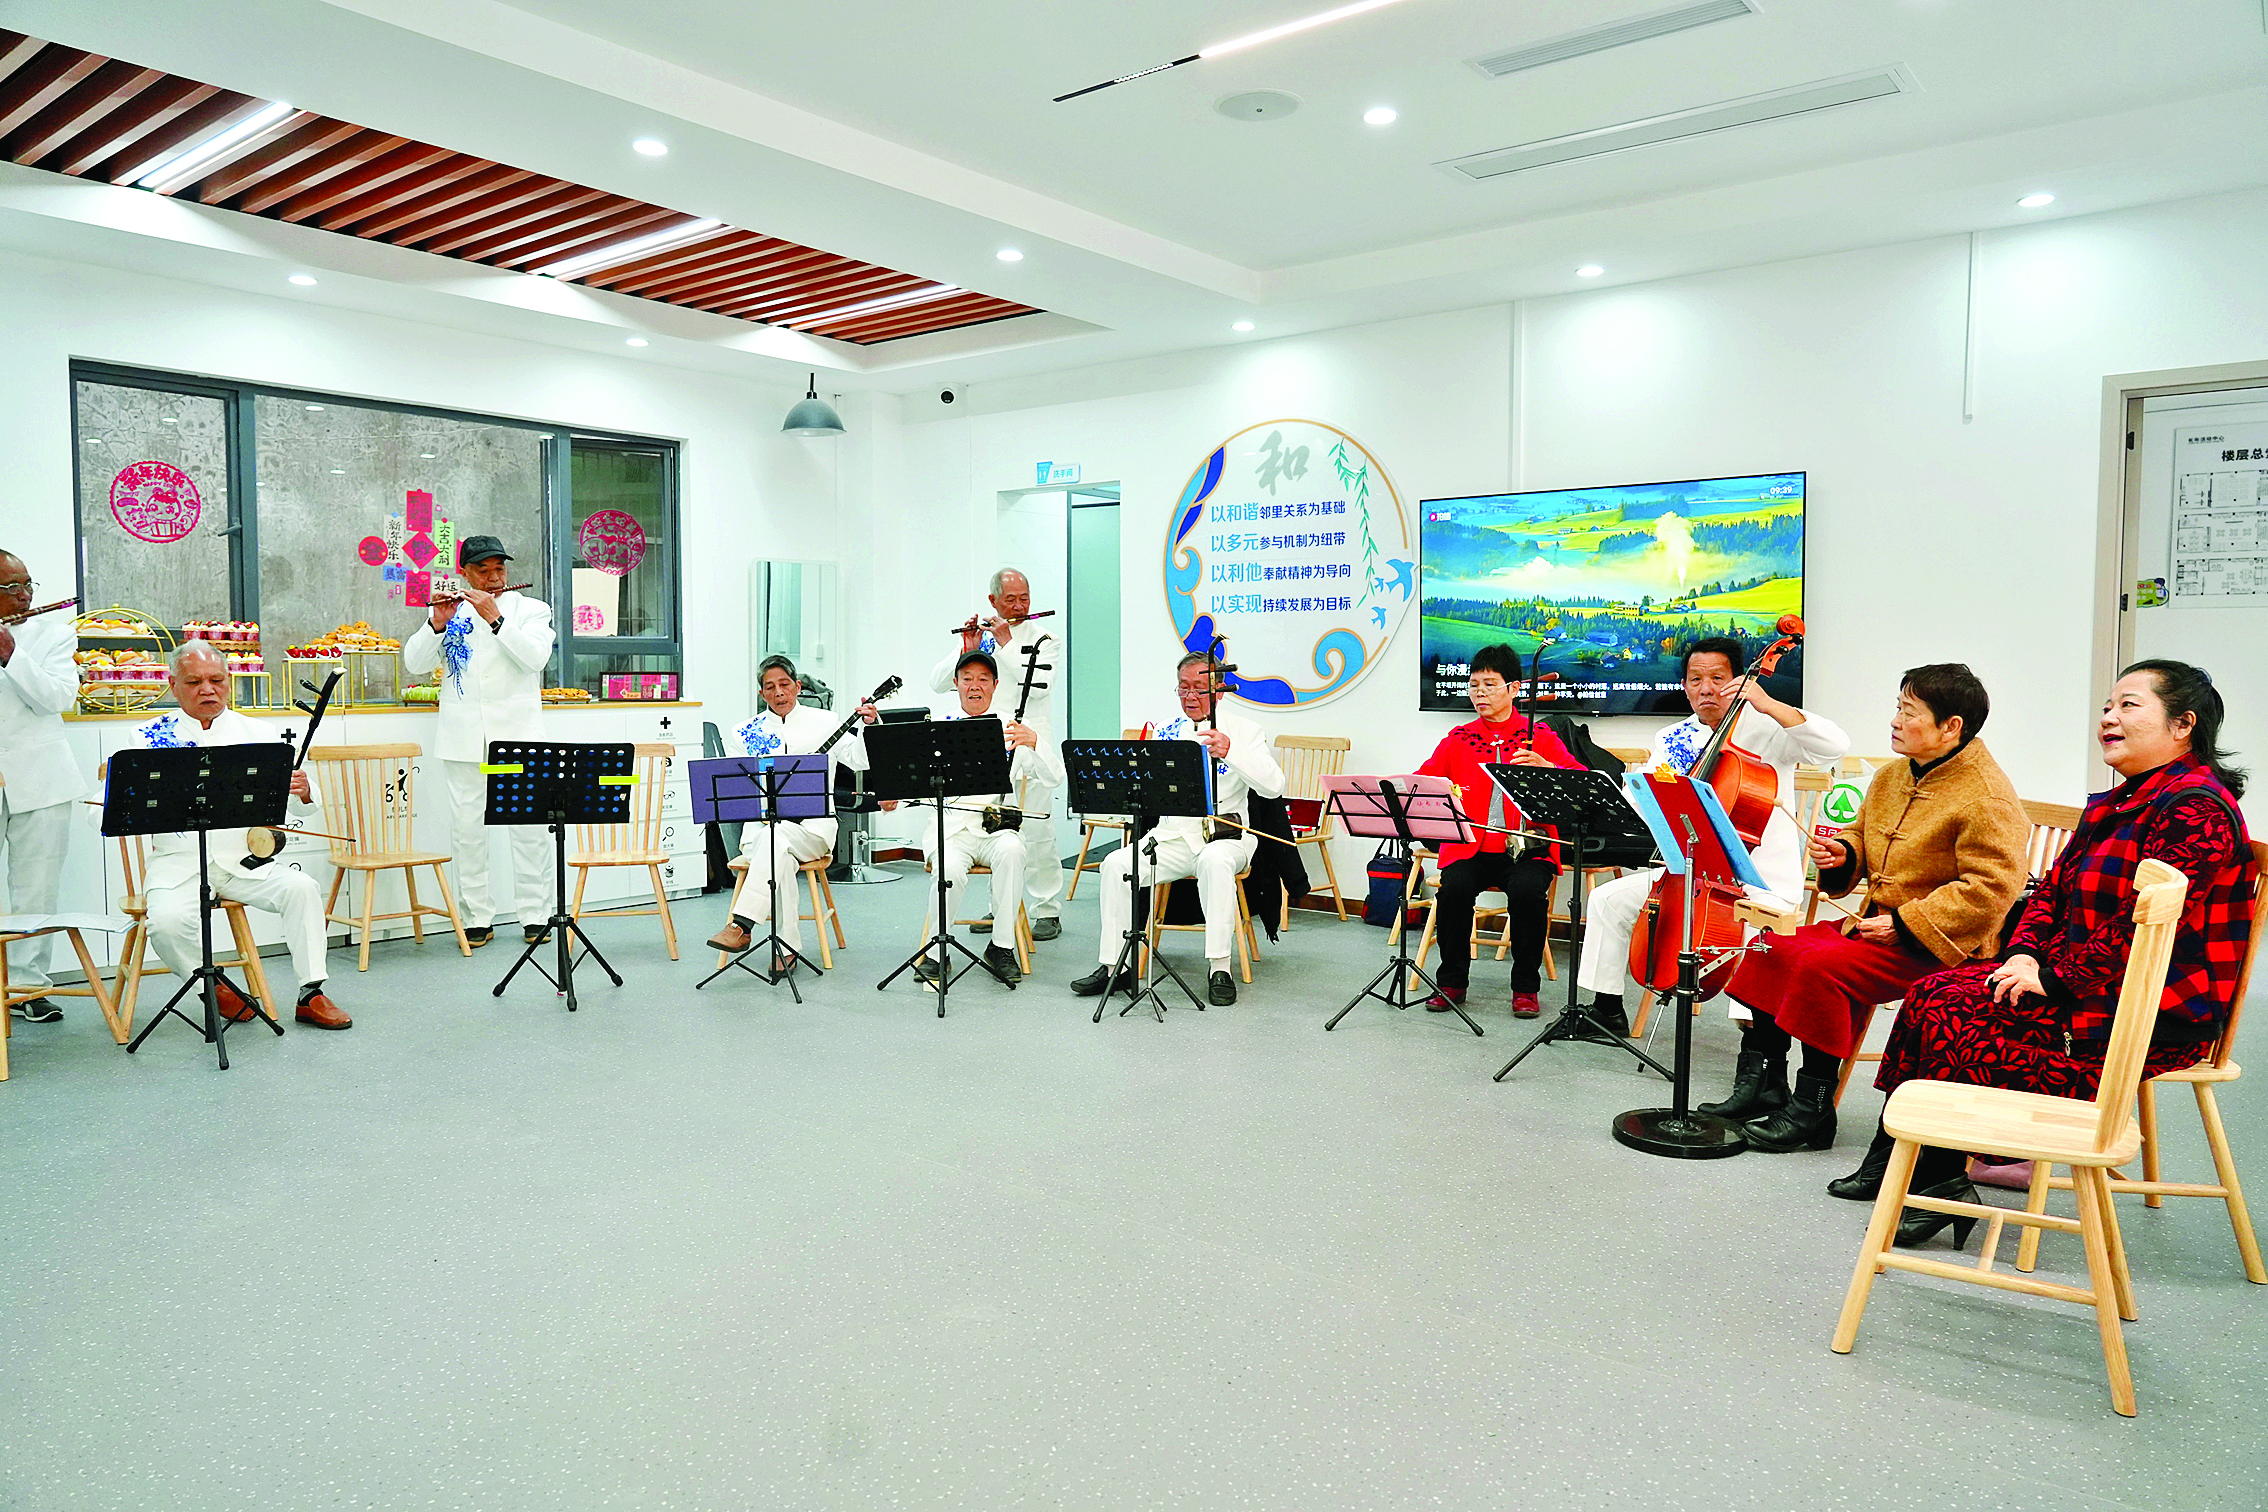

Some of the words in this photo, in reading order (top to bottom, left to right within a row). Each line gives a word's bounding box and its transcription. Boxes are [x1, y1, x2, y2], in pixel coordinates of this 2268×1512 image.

[1254, 430, 1311, 497] 和
[2221, 447, 2268, 462] 楼层总
[1770, 486, 1793, 495] 09:39
[386, 519, 402, 560] 新年快乐
[438, 525, 451, 566] 大吉大利
[434, 580, 459, 591] 好运
